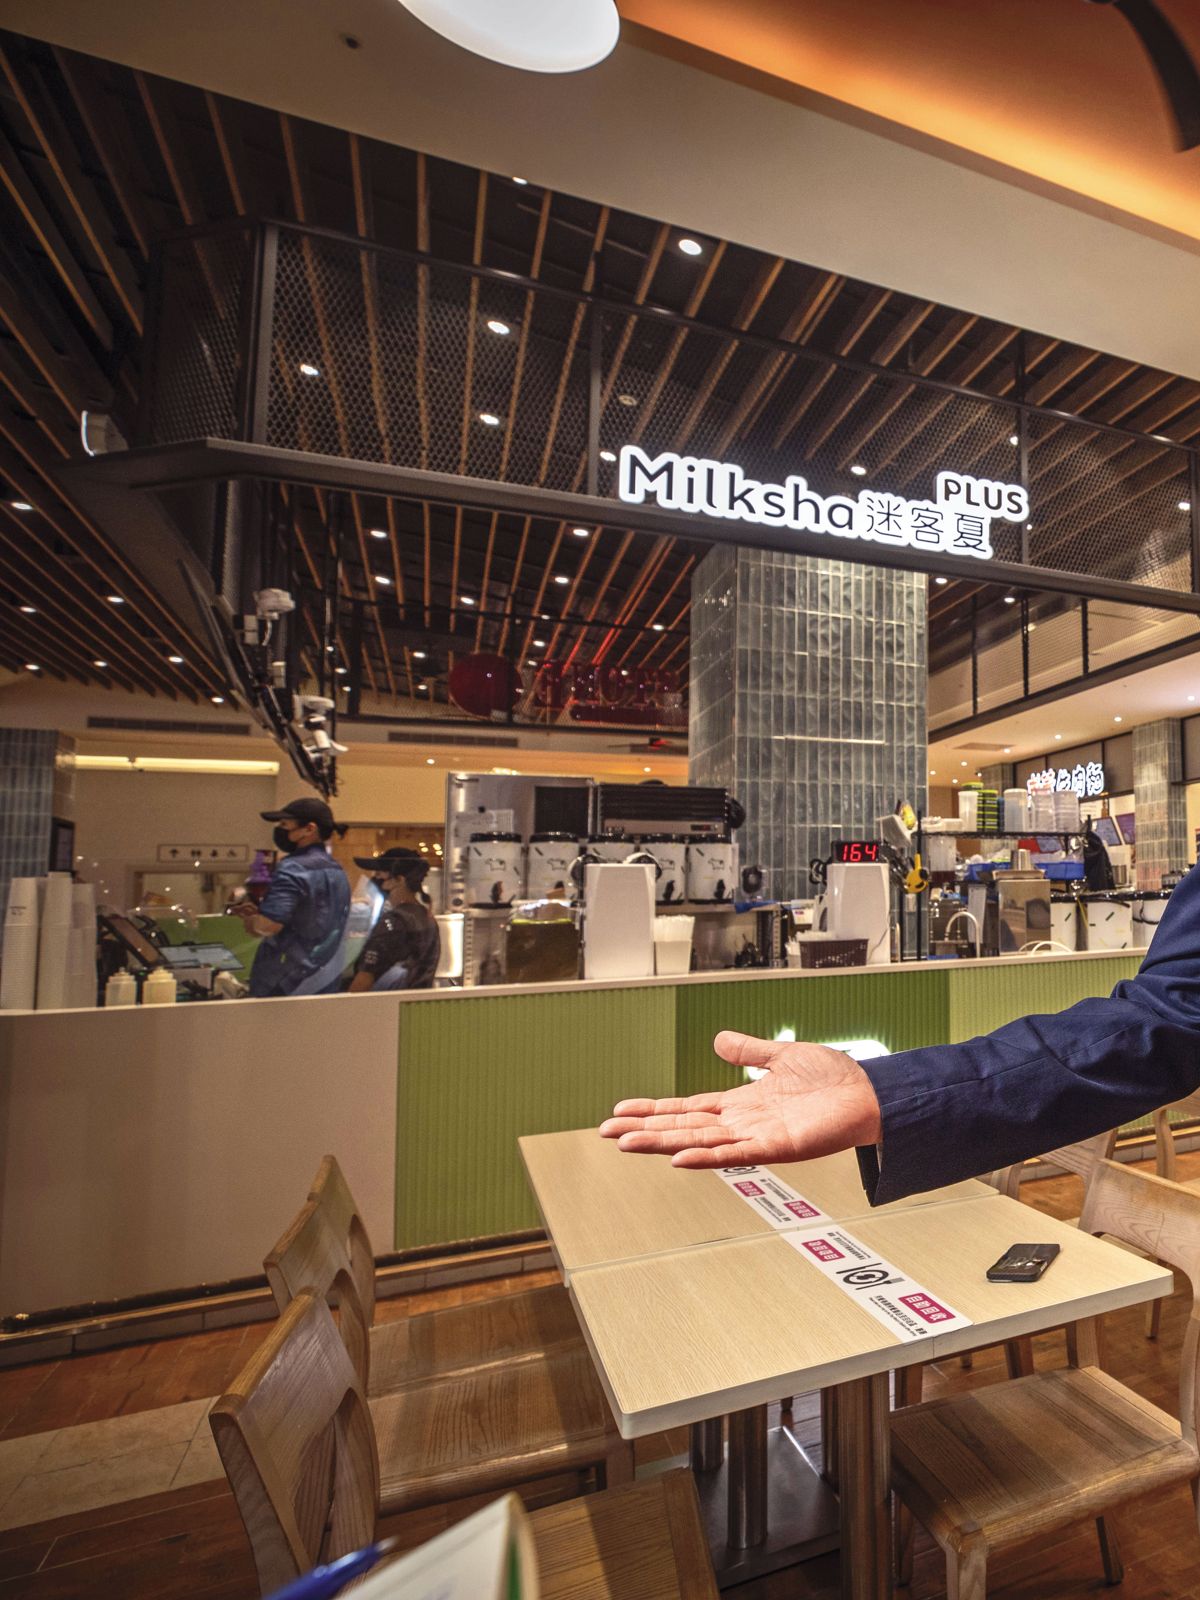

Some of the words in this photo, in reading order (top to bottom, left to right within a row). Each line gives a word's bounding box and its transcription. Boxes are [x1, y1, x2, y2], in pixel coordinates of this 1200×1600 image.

[628, 454, 854, 531] Milksha
[944, 478, 1023, 515] PLUS
[865, 496, 987, 553] 迷客夏
[842, 843, 878, 862] 164
